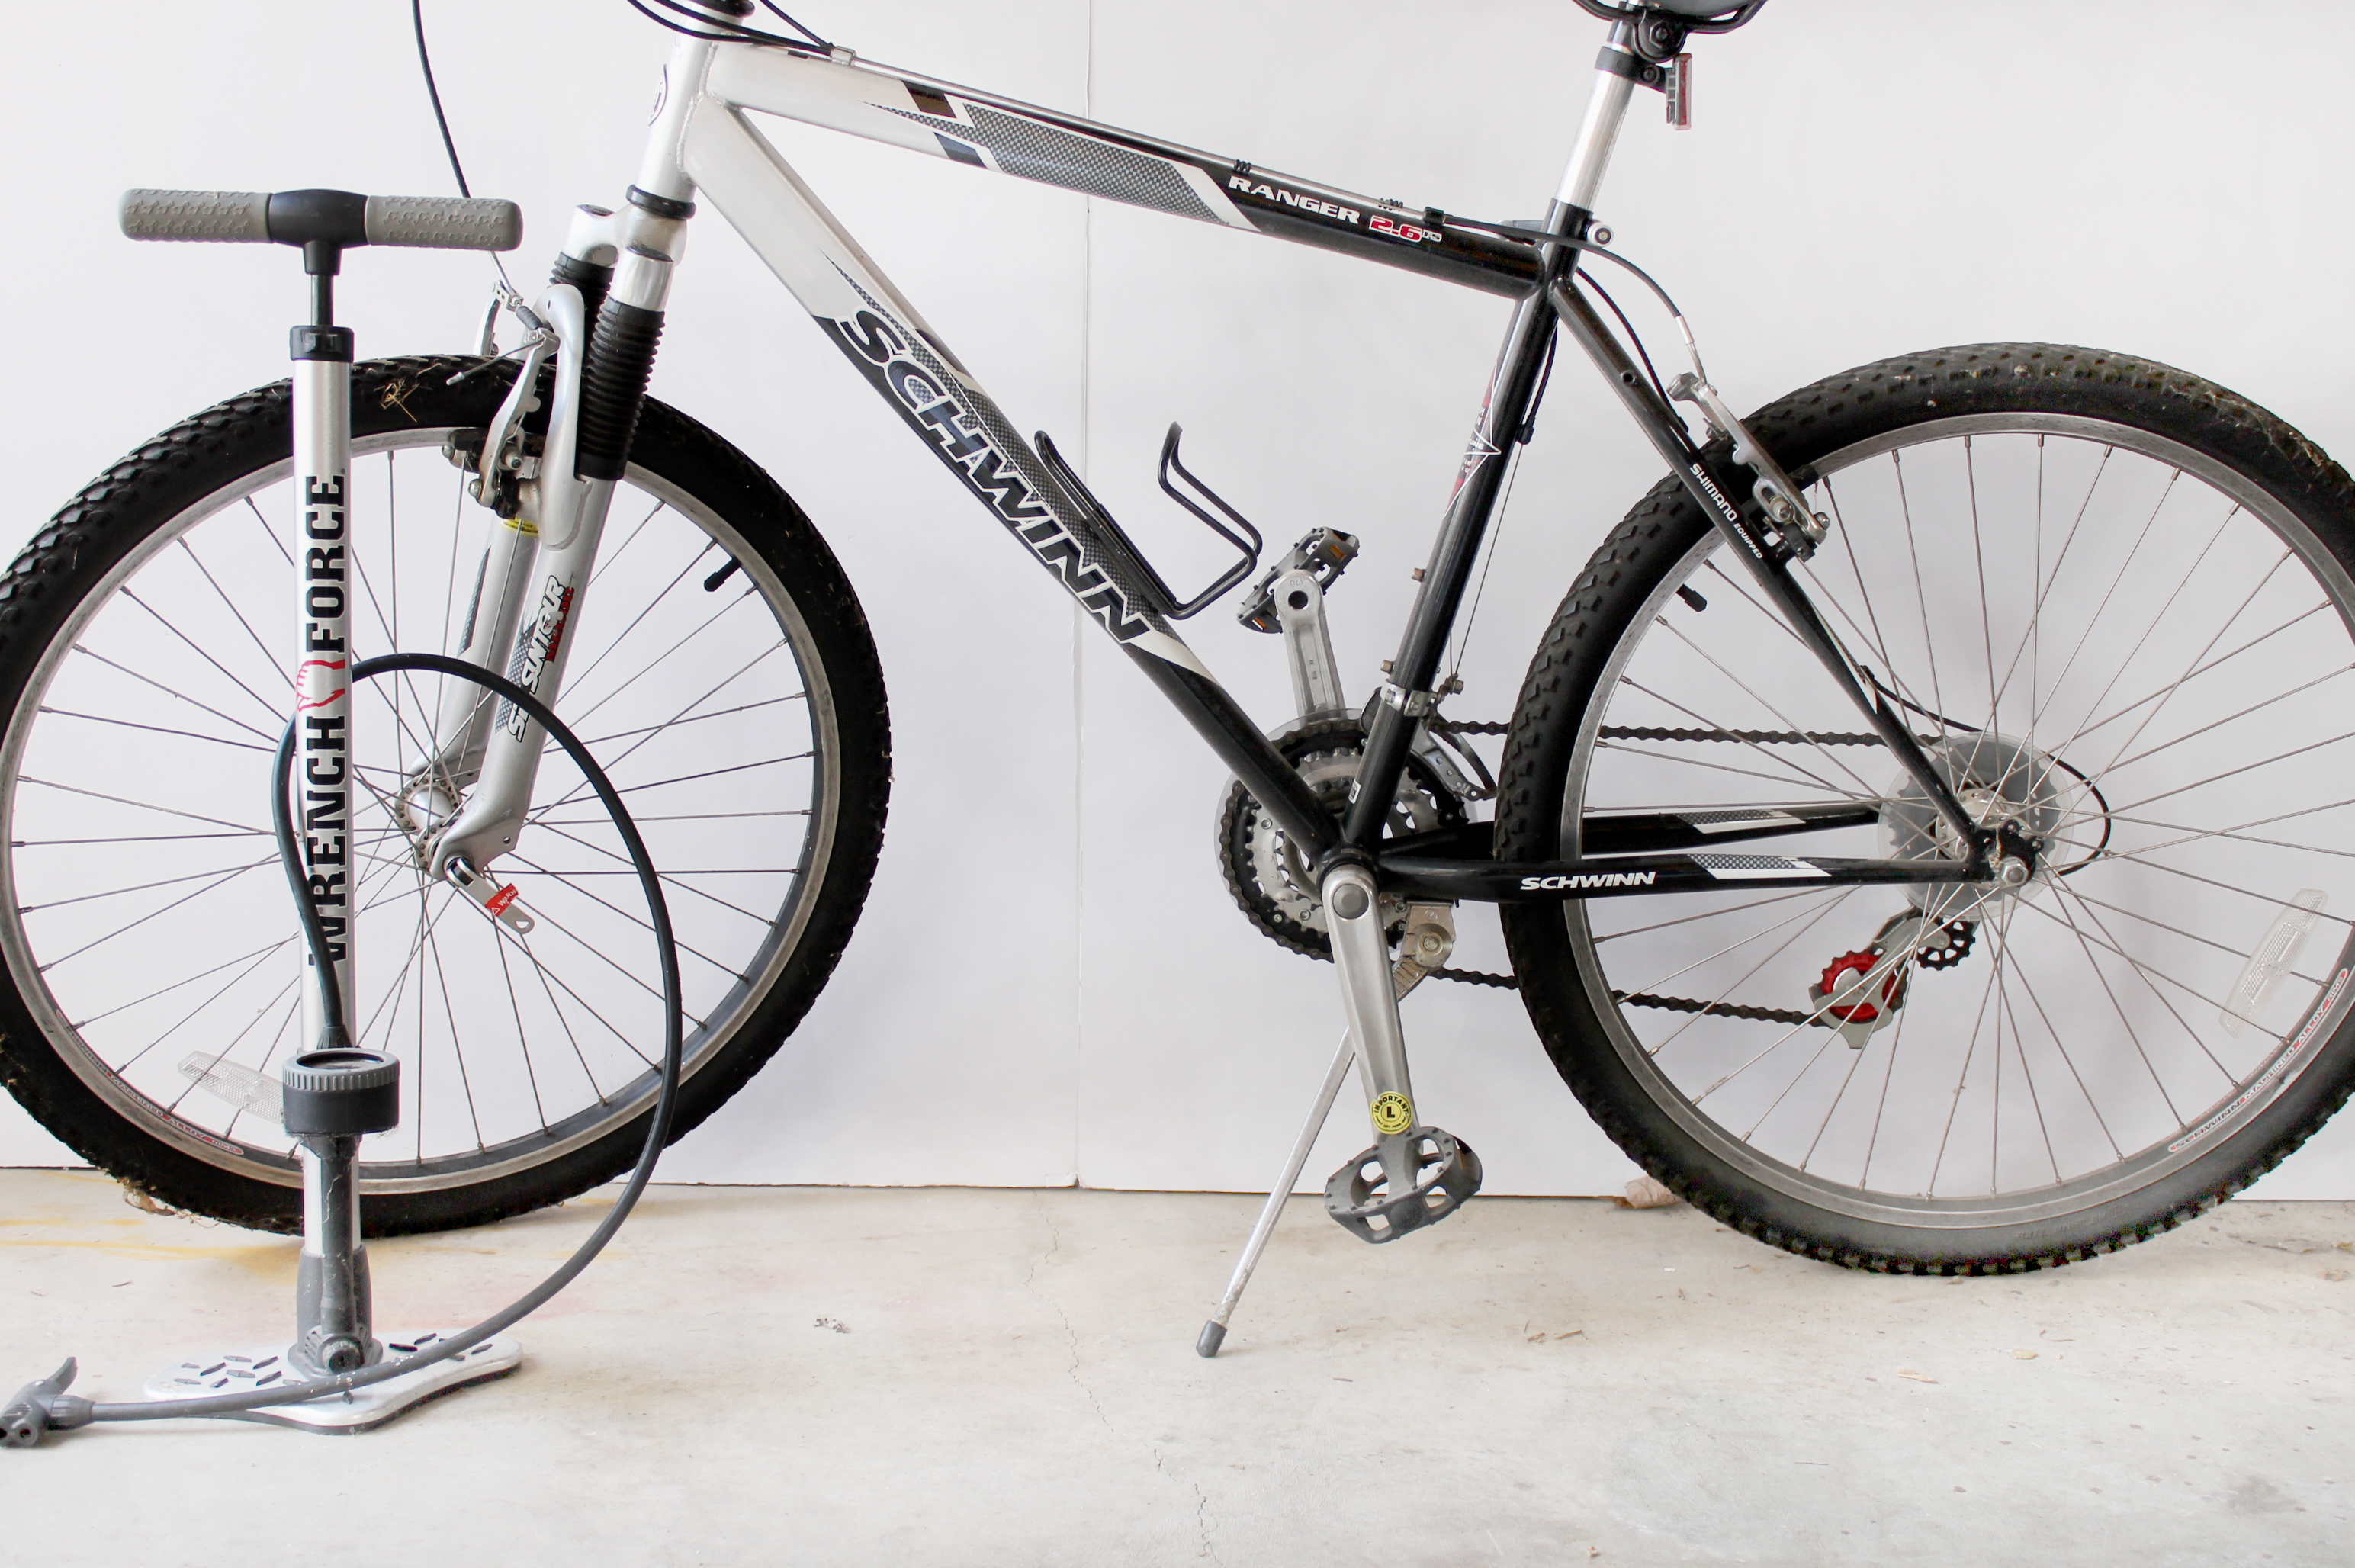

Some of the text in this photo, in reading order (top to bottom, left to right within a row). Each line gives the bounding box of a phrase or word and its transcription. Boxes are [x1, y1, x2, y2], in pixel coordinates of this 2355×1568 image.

[1228, 175, 1361, 224] RANGER
[834, 307, 1153, 643] SCHWINN
[1690, 463, 1763, 559] SHIMANO EQUIPPED
[306, 476, 345, 653] FORCE
[521, 575, 566, 695] SUNTOUR
[1521, 872, 1656, 890] SCHWINN
[2244, 1047, 2295, 1100] MACHINED
[2299, 1005, 2324, 1043] ALLOY
[169, 1118, 206, 1139] ALLOY
[1374, 1095, 1409, 1113] IMPORTANT
[1386, 1106, 1396, 1118] L
